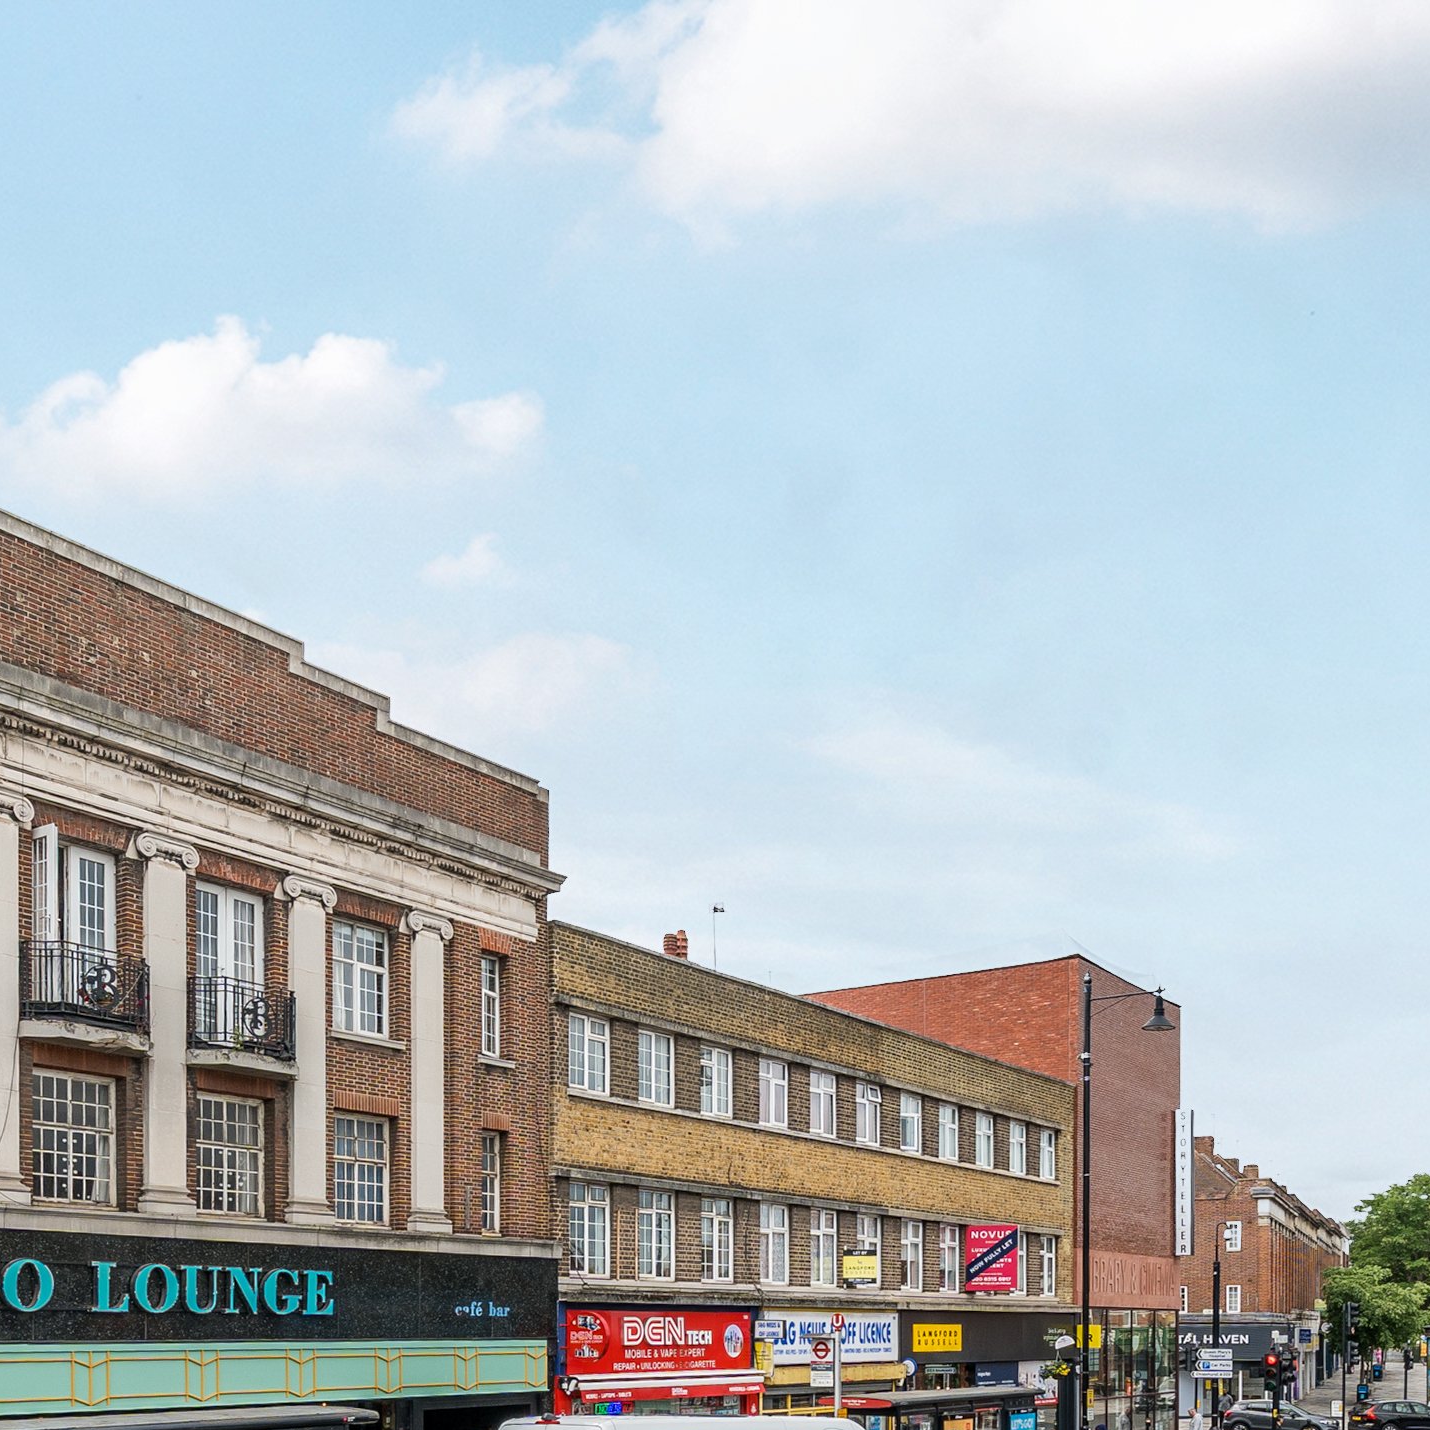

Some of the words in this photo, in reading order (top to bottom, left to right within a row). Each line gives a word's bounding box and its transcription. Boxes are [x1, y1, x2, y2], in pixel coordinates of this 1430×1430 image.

[1179, 1111, 1187, 1254] STORYTELLER
[970, 1260, 984, 1273] NOW
[984, 1248, 1002, 1264] FULLY
[1002, 1239, 1013, 1250] LET
[91, 1260, 334, 1316] LOUNGE
[1139, 1264, 1175, 1297] CINEMA
[455, 1301, 482, 1318] café
[488, 1303, 510, 1318] bar
[833, 1315, 842, 1327] U
[686, 1330, 713, 1345] TECH
[859, 1322, 891, 1344] LICENCE
[917, 1330, 958, 1338] LANGFORD
[624, 1349, 652, 1359] MOBILE
[653, 1349, 658, 1358] &
[660, 1348, 677, 1358] VAPE
[679, 1348, 705, 1357] EXPERT
[613, 1362, 636, 1371] REPAIR
[640, 1361, 674, 1370] UNLOCKING
